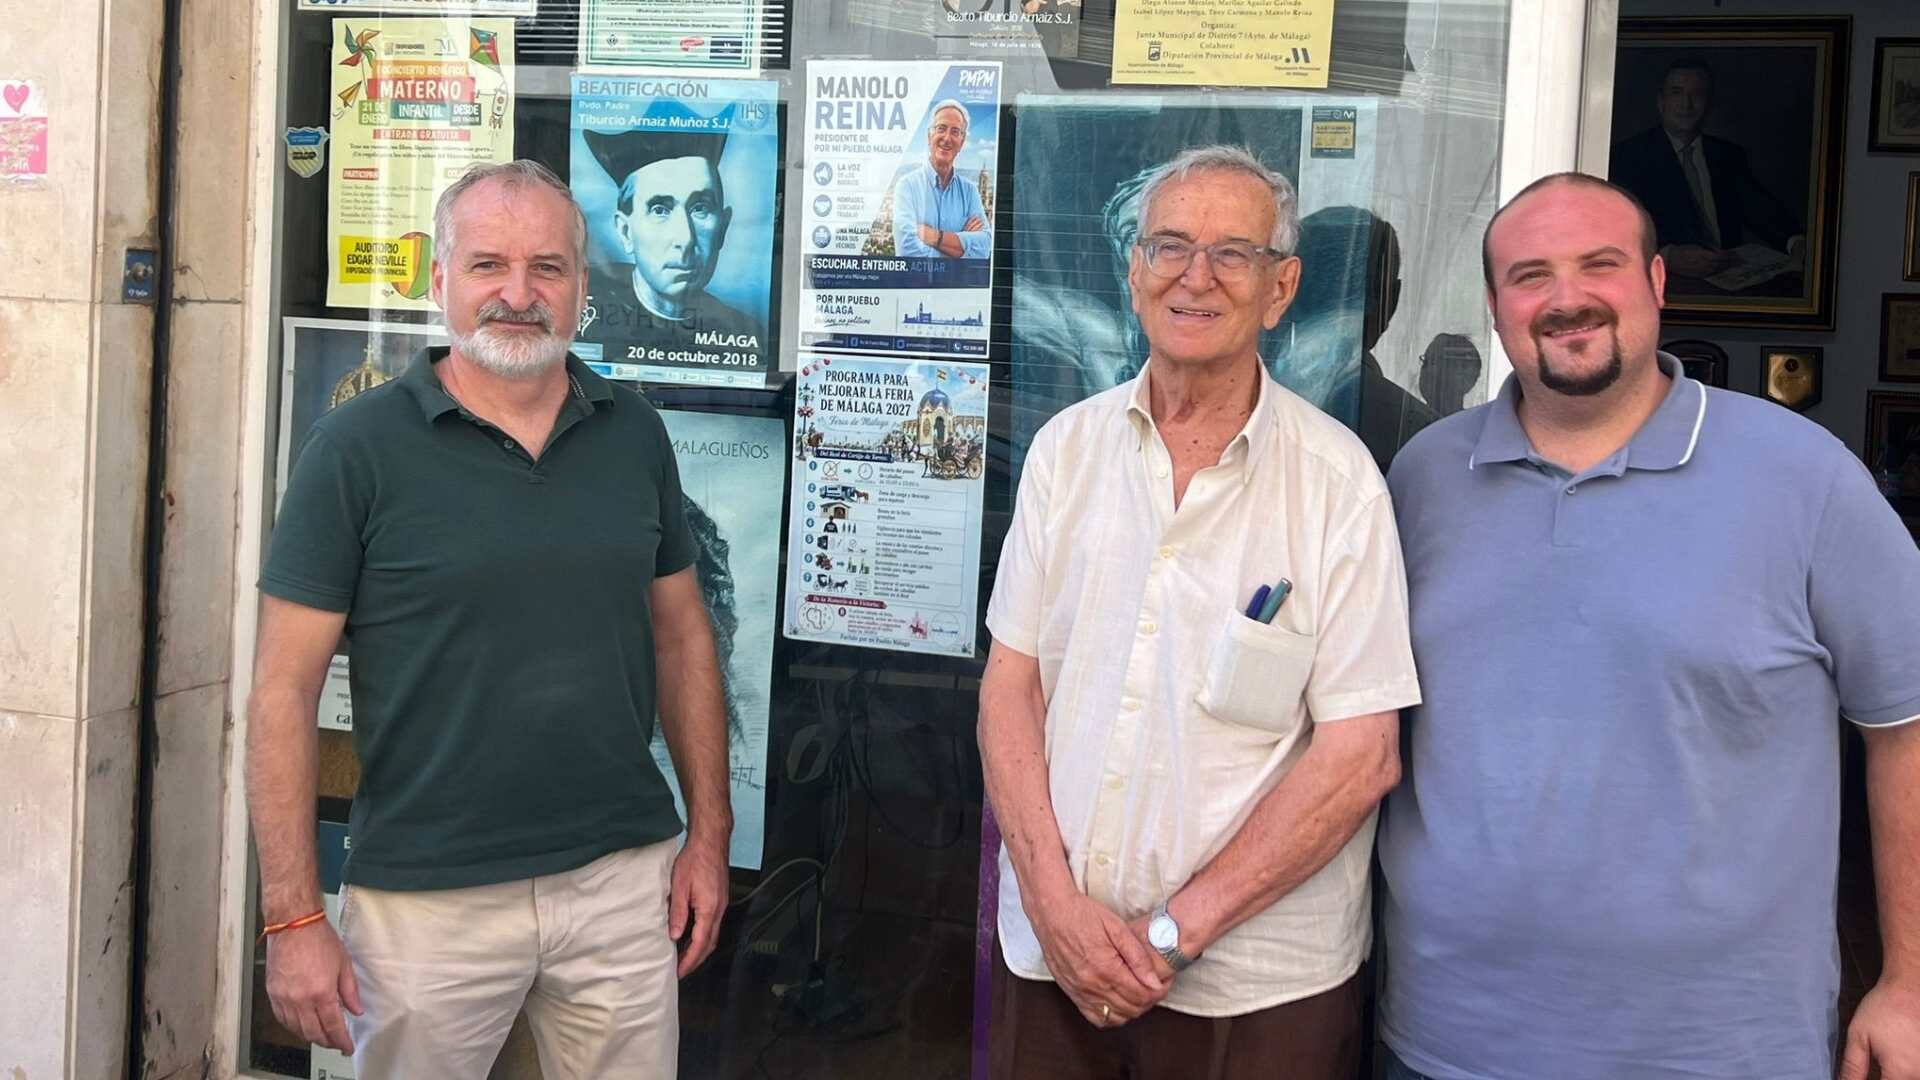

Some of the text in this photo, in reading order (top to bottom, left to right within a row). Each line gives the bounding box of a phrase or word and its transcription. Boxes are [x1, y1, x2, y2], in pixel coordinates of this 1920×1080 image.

[947, 11, 975, 22] Beato
[978, 11, 1018, 22] Tiburcio
[1055, 13, 1073, 24] S.J.
[1136, 31, 1156, 40] Junta
[1158, 31, 1195, 41] Municipal
[1197, 31, 1206, 39] de
[1208, 32, 1237, 40] Distrito
[1269, 32, 1278, 40] de
[959, 69, 996, 87] PMPM
[380, 80, 461, 99] MATERNO
[579, 80, 708, 98] BEATIFICACIÓN
[816, 76, 909, 99] MANOLO
[399, 104, 443, 117] INFANTIL
[605, 101, 631, 110] Padre
[578, 113, 625, 126] Tiburcio
[669, 116, 708, 128] Muñoz
[712, 117, 731, 130] S.J.
[815, 101, 907, 130] REINA
[815, 134, 868, 143] PRESIDENTE DE
[843, 145, 872, 153] PUEBLO
[873, 145, 903, 154] MÁLAGA
[848, 163, 860, 172] VOZ
[355, 242, 399, 254] AUDITORIO
[347, 254, 373, 265] EDGAR
[812, 257, 861, 270] ESCUCHAR.
[862, 259, 909, 272] ENTENDER.
[816, 294, 880, 305] POR MI PUEBLO
[694, 330, 758, 348] MÁLAGA
[627, 347, 758, 366] 20 de octubre 2018
[825, 370, 908, 386] PROGRAMA PARA
[819, 384, 914, 401] MEJORAR LA FERIA
[820, 398, 911, 416] DE MÁLAGA 2027
